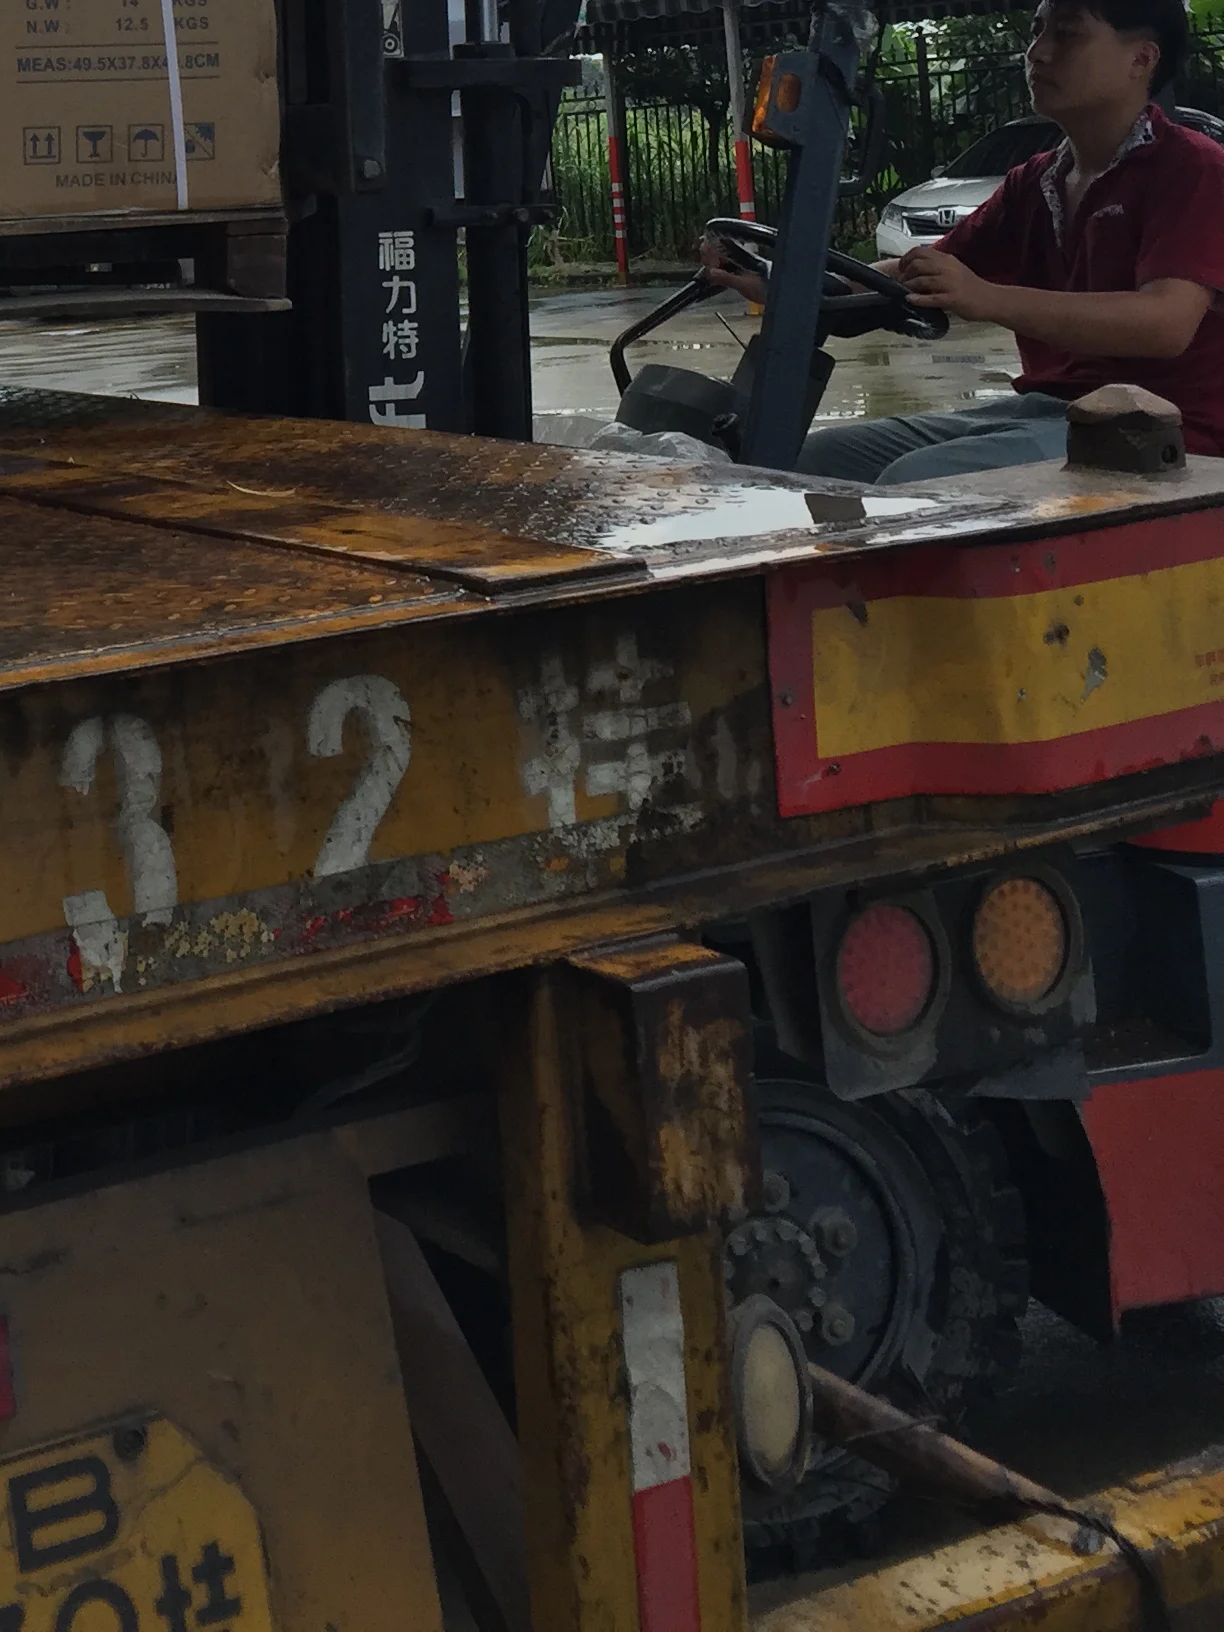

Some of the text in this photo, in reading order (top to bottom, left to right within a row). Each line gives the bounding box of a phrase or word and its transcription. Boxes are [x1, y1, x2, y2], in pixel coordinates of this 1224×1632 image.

[116, 18, 148, 31] 12.5
[56, 174, 104, 189] MADE
[110, 173, 126, 186] IN
[378, 230, 419, 360] 福力特
